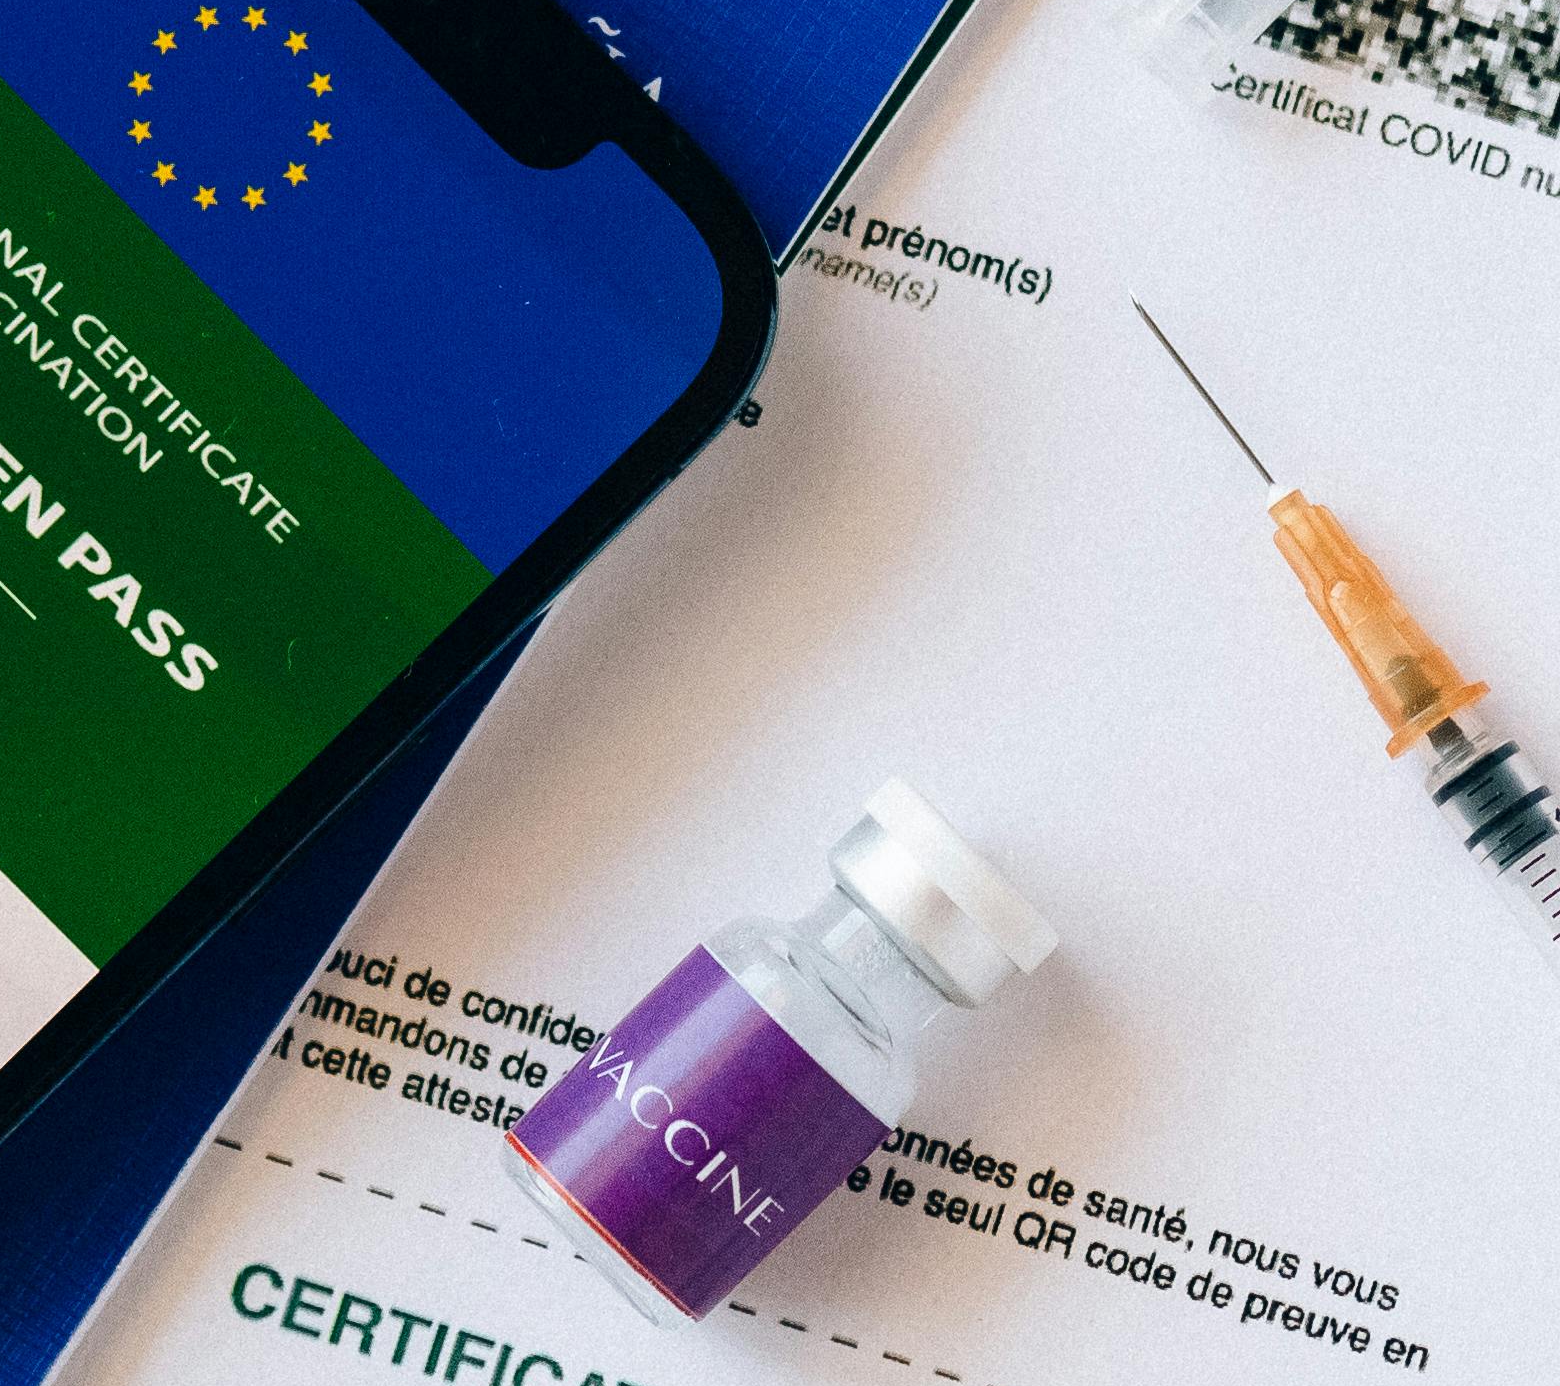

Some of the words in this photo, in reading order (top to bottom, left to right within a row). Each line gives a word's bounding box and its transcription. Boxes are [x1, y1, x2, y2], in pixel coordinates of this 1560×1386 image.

[1379, 112, 1510, 179] COVID
[859, 217, 1052, 305] prénom(s)
[71, 313, 299, 543] CERTIFICATE
[57, 531, 218, 691] PASS
[402, 966, 451, 1007] de
[300, 1039, 391, 1090] cette
[498, 1048, 548, 1088] de
[587, 1032, 786, 1240] VACCINE
[878, 1165, 916, 1207] le
[922, 1188, 1006, 1236] seul
[1012, 1210, 1077, 1259] QR
[1084, 1240, 1177, 1290] code
[1186, 1269, 1233, 1309] de
[1239, 1291, 1371, 1354] preuve
[1381, 1336, 1429, 1371] en
[1026, 1166, 1075, 1207] de
[1082, 1189, 1194, 1251] santé,
[1207, 1229, 1300, 1280] nous
[1312, 1261, 1399, 1311] vous
